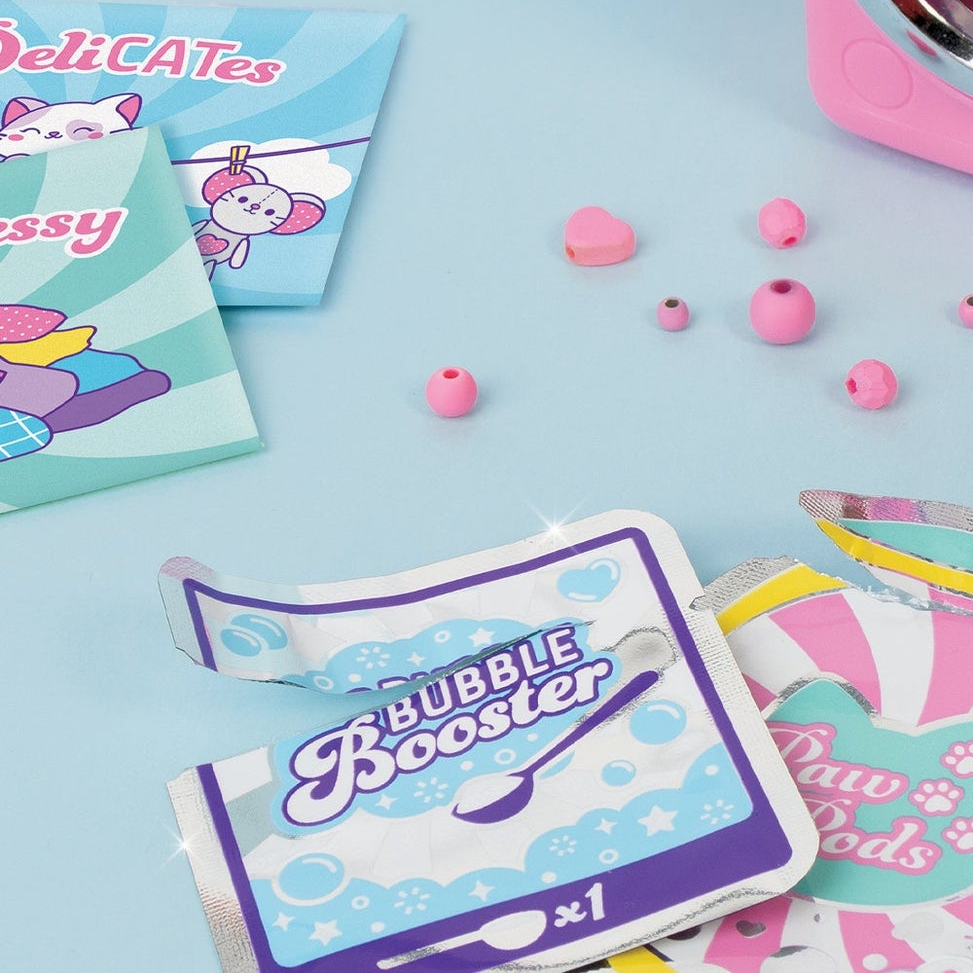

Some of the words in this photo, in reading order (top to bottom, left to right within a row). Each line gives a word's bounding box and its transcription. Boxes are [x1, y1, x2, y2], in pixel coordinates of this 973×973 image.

[384, 627, 580, 733] BUBBLE
[283, 660, 610, 825] Booster
[553, 882, 606, 928] x1
